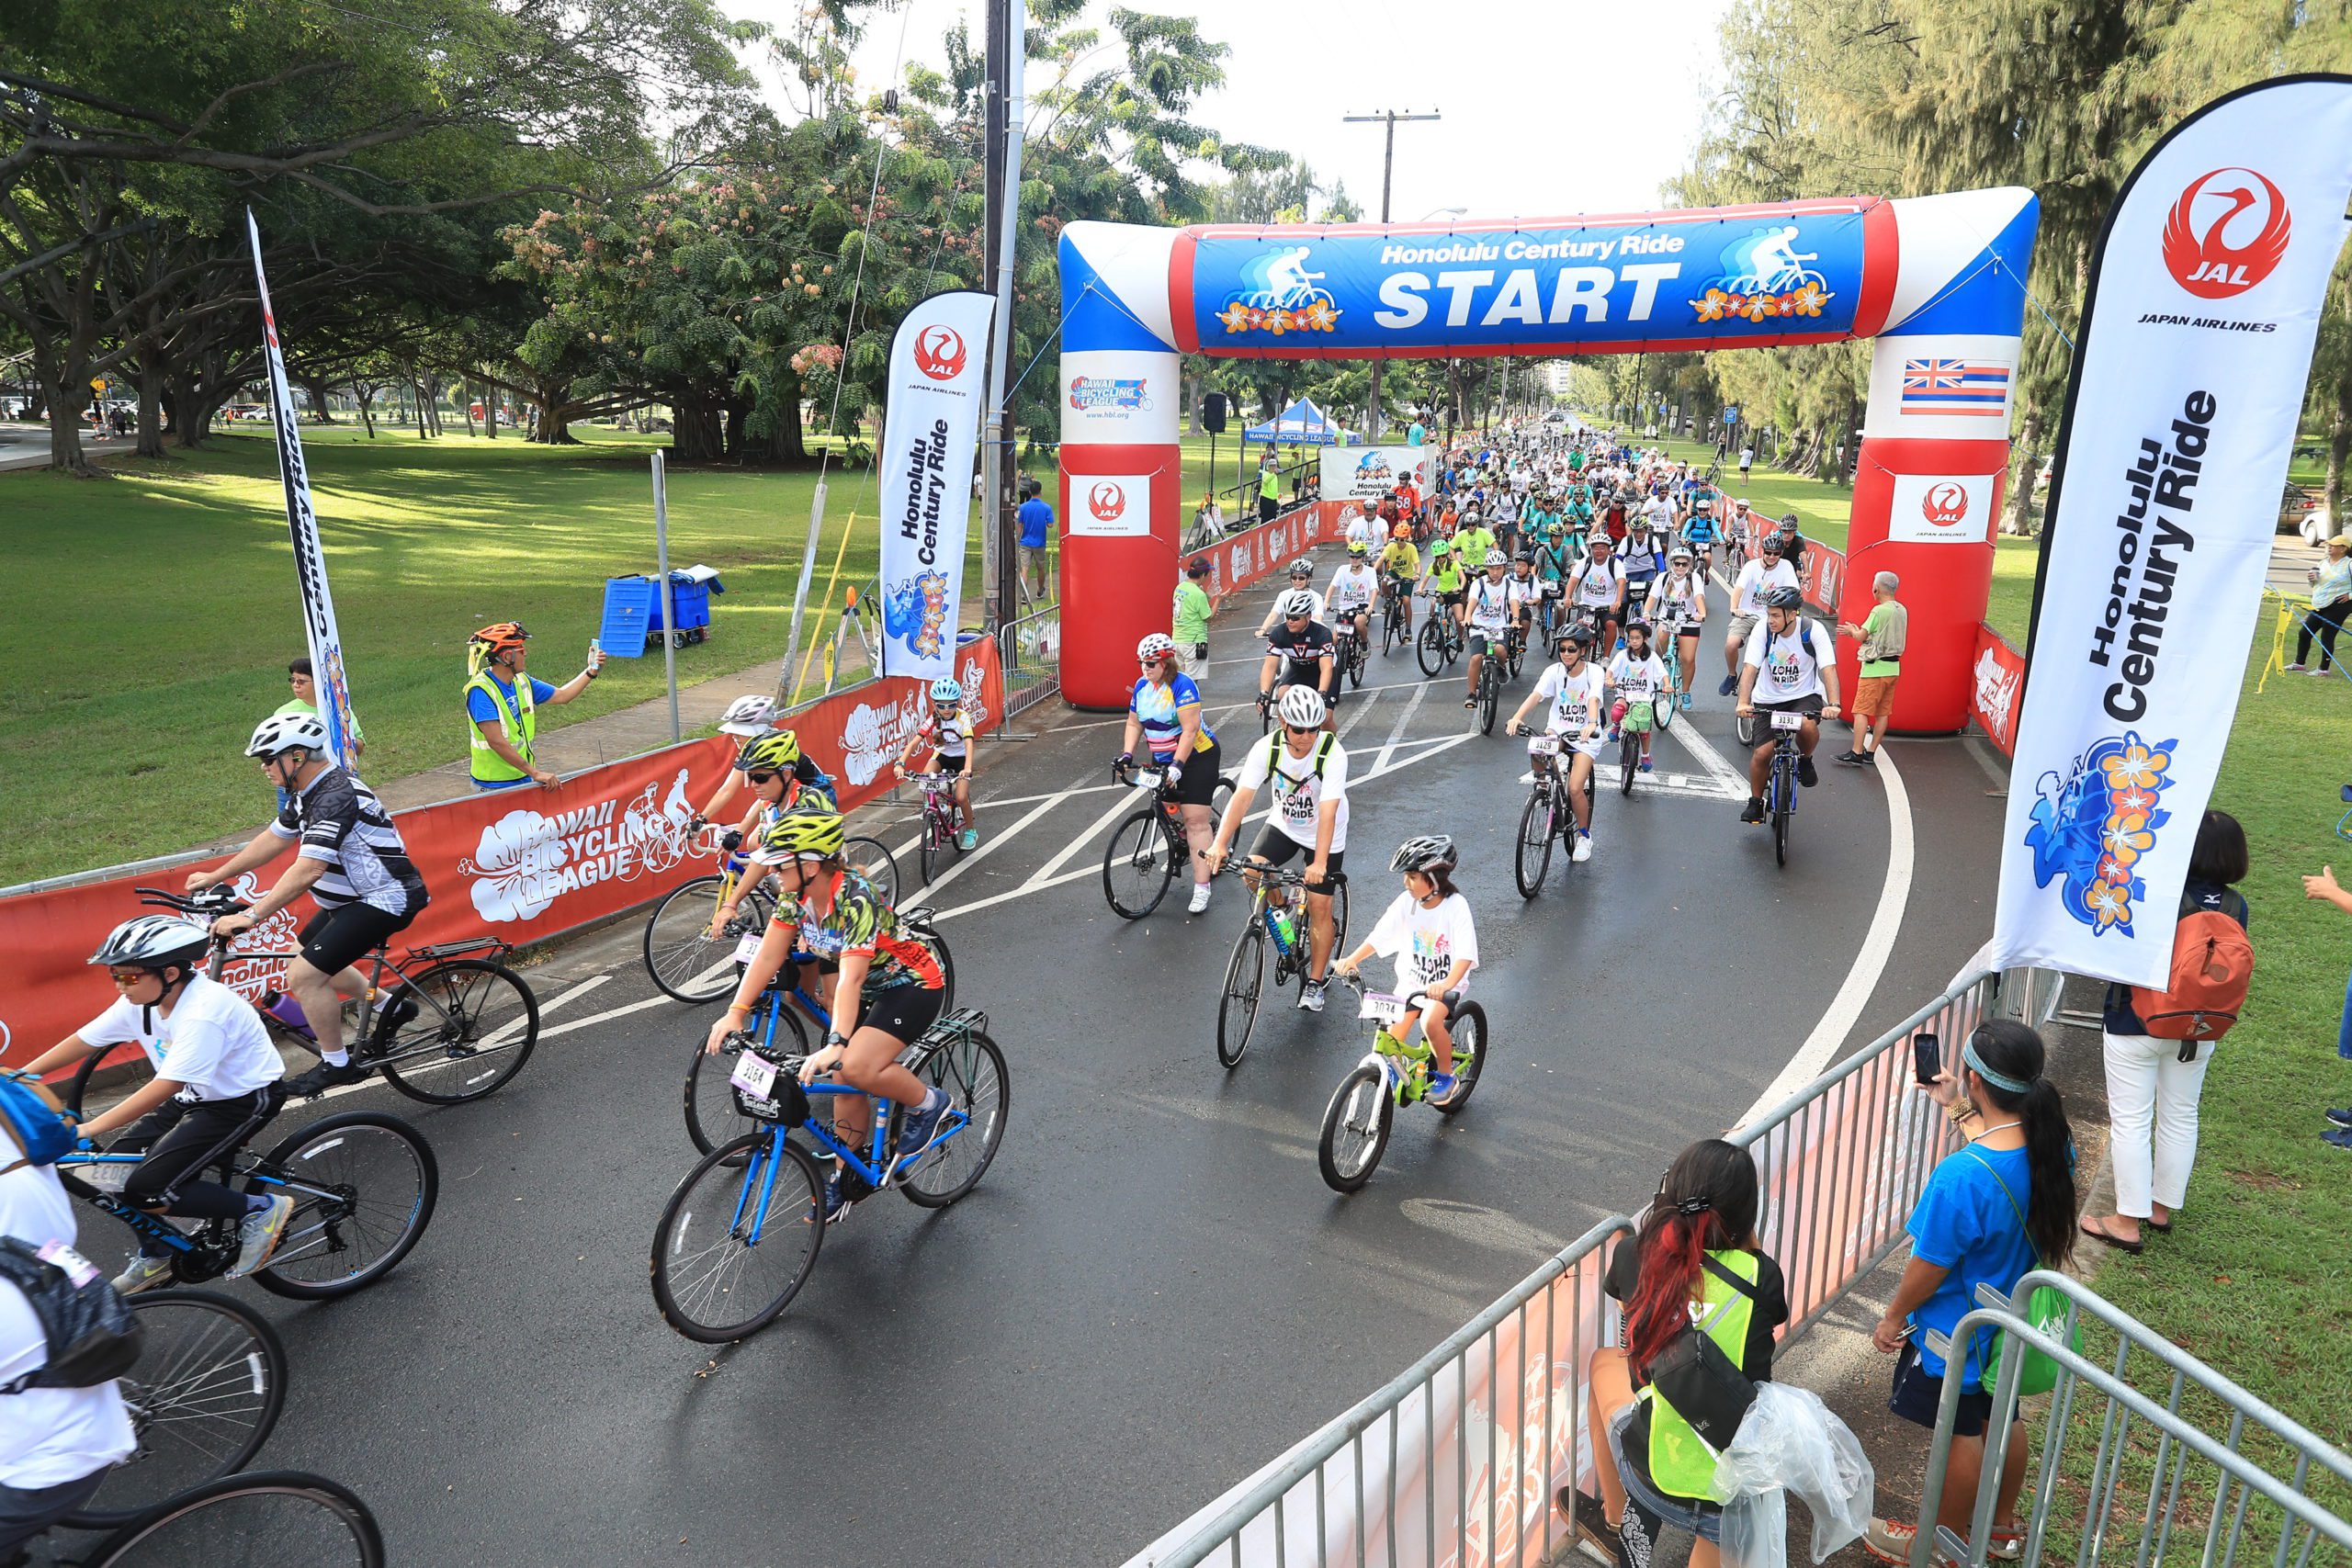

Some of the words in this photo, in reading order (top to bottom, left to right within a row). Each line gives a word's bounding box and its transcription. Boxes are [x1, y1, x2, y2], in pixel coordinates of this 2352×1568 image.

[1380, 244, 1499, 265] Honolulu
[1504, 239, 1616, 261] Century
[1620, 232, 1685, 255] Ride
[2186, 261, 2251, 286] JAL
[1374, 263, 1681, 329] START
[2137, 313, 2190, 325] JAPAN
[2191, 318, 2278, 333] AIRLINES
[927, 364, 955, 376] JAL
[932, 388, 967, 397] AIRLINES
[1080, 379, 1115, 389] HAWAII
[1081, 388, 1136, 398] BICYCLING
[1081, 397, 1119, 407] LEAGUE
[1086, 412, 1129, 420] www.hbl.org
[286, 408, 306, 491] Ride
[927, 419, 948, 472] Ride
[901, 438, 927, 540] Honolulu
[1349, 490, 1380, 498] Century
[1396, 496, 1411, 509] 58
[918, 474, 946, 565] Century
[1097, 509, 1119, 517] JAL
[2089, 437, 2162, 667] Honolulu
[2103, 515, 2195, 723] Century
[2154, 389, 2216, 512] Ride
[294, 494, 327, 637] Century
[1585, 583, 1607, 592] ALOHA
[1622, 677, 1647, 687] ALOHA
[1782, 674, 1800, 683] RIDE
[1778, 716, 1794, 725] 3131
[1535, 741, 1552, 750] 3129
[1290, 808, 1315, 818] RIDE
[522, 798, 617, 851] HAWAII
[520, 814, 665, 878] BICYCLING
[525, 848, 634, 907] LEAGUE
[220, 957, 288, 986] nolulu
[1429, 970, 1449, 984] RID
[1374, 1000, 1396, 1014] 3034
[743, 1063, 764, 1085] 3164
[94, 1195, 166, 1238] GIANT
